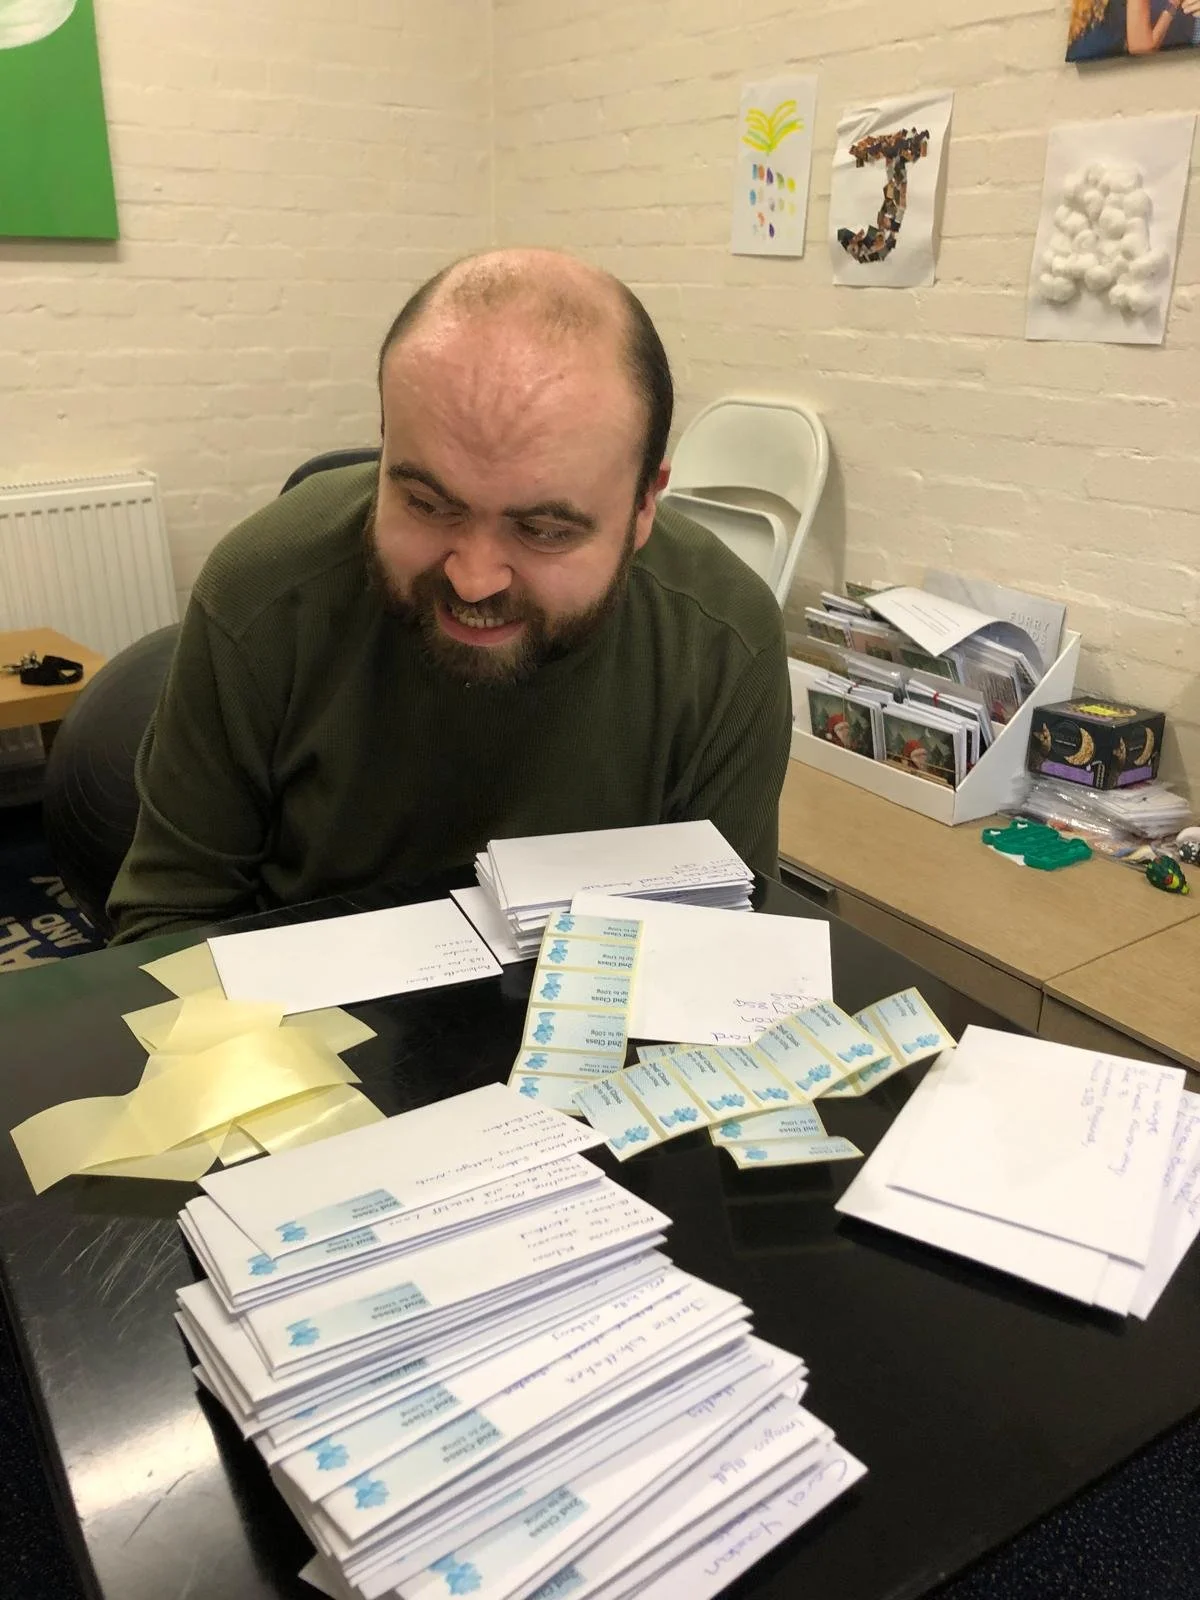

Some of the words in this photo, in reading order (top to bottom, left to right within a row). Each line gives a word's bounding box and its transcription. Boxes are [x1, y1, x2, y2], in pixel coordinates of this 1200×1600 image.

[403, 1297, 426, 1309] 2nd
[370, 1306, 402, 1320] Class
[433, 1394, 457, 1410] 2nd
[399, 1407, 434, 1428] Class
[475, 1427, 498, 1444] 2nd
[442, 1441, 476, 1464] Class
[557, 1495, 584, 1516] 2nd
[526, 1513, 561, 1538] Class
